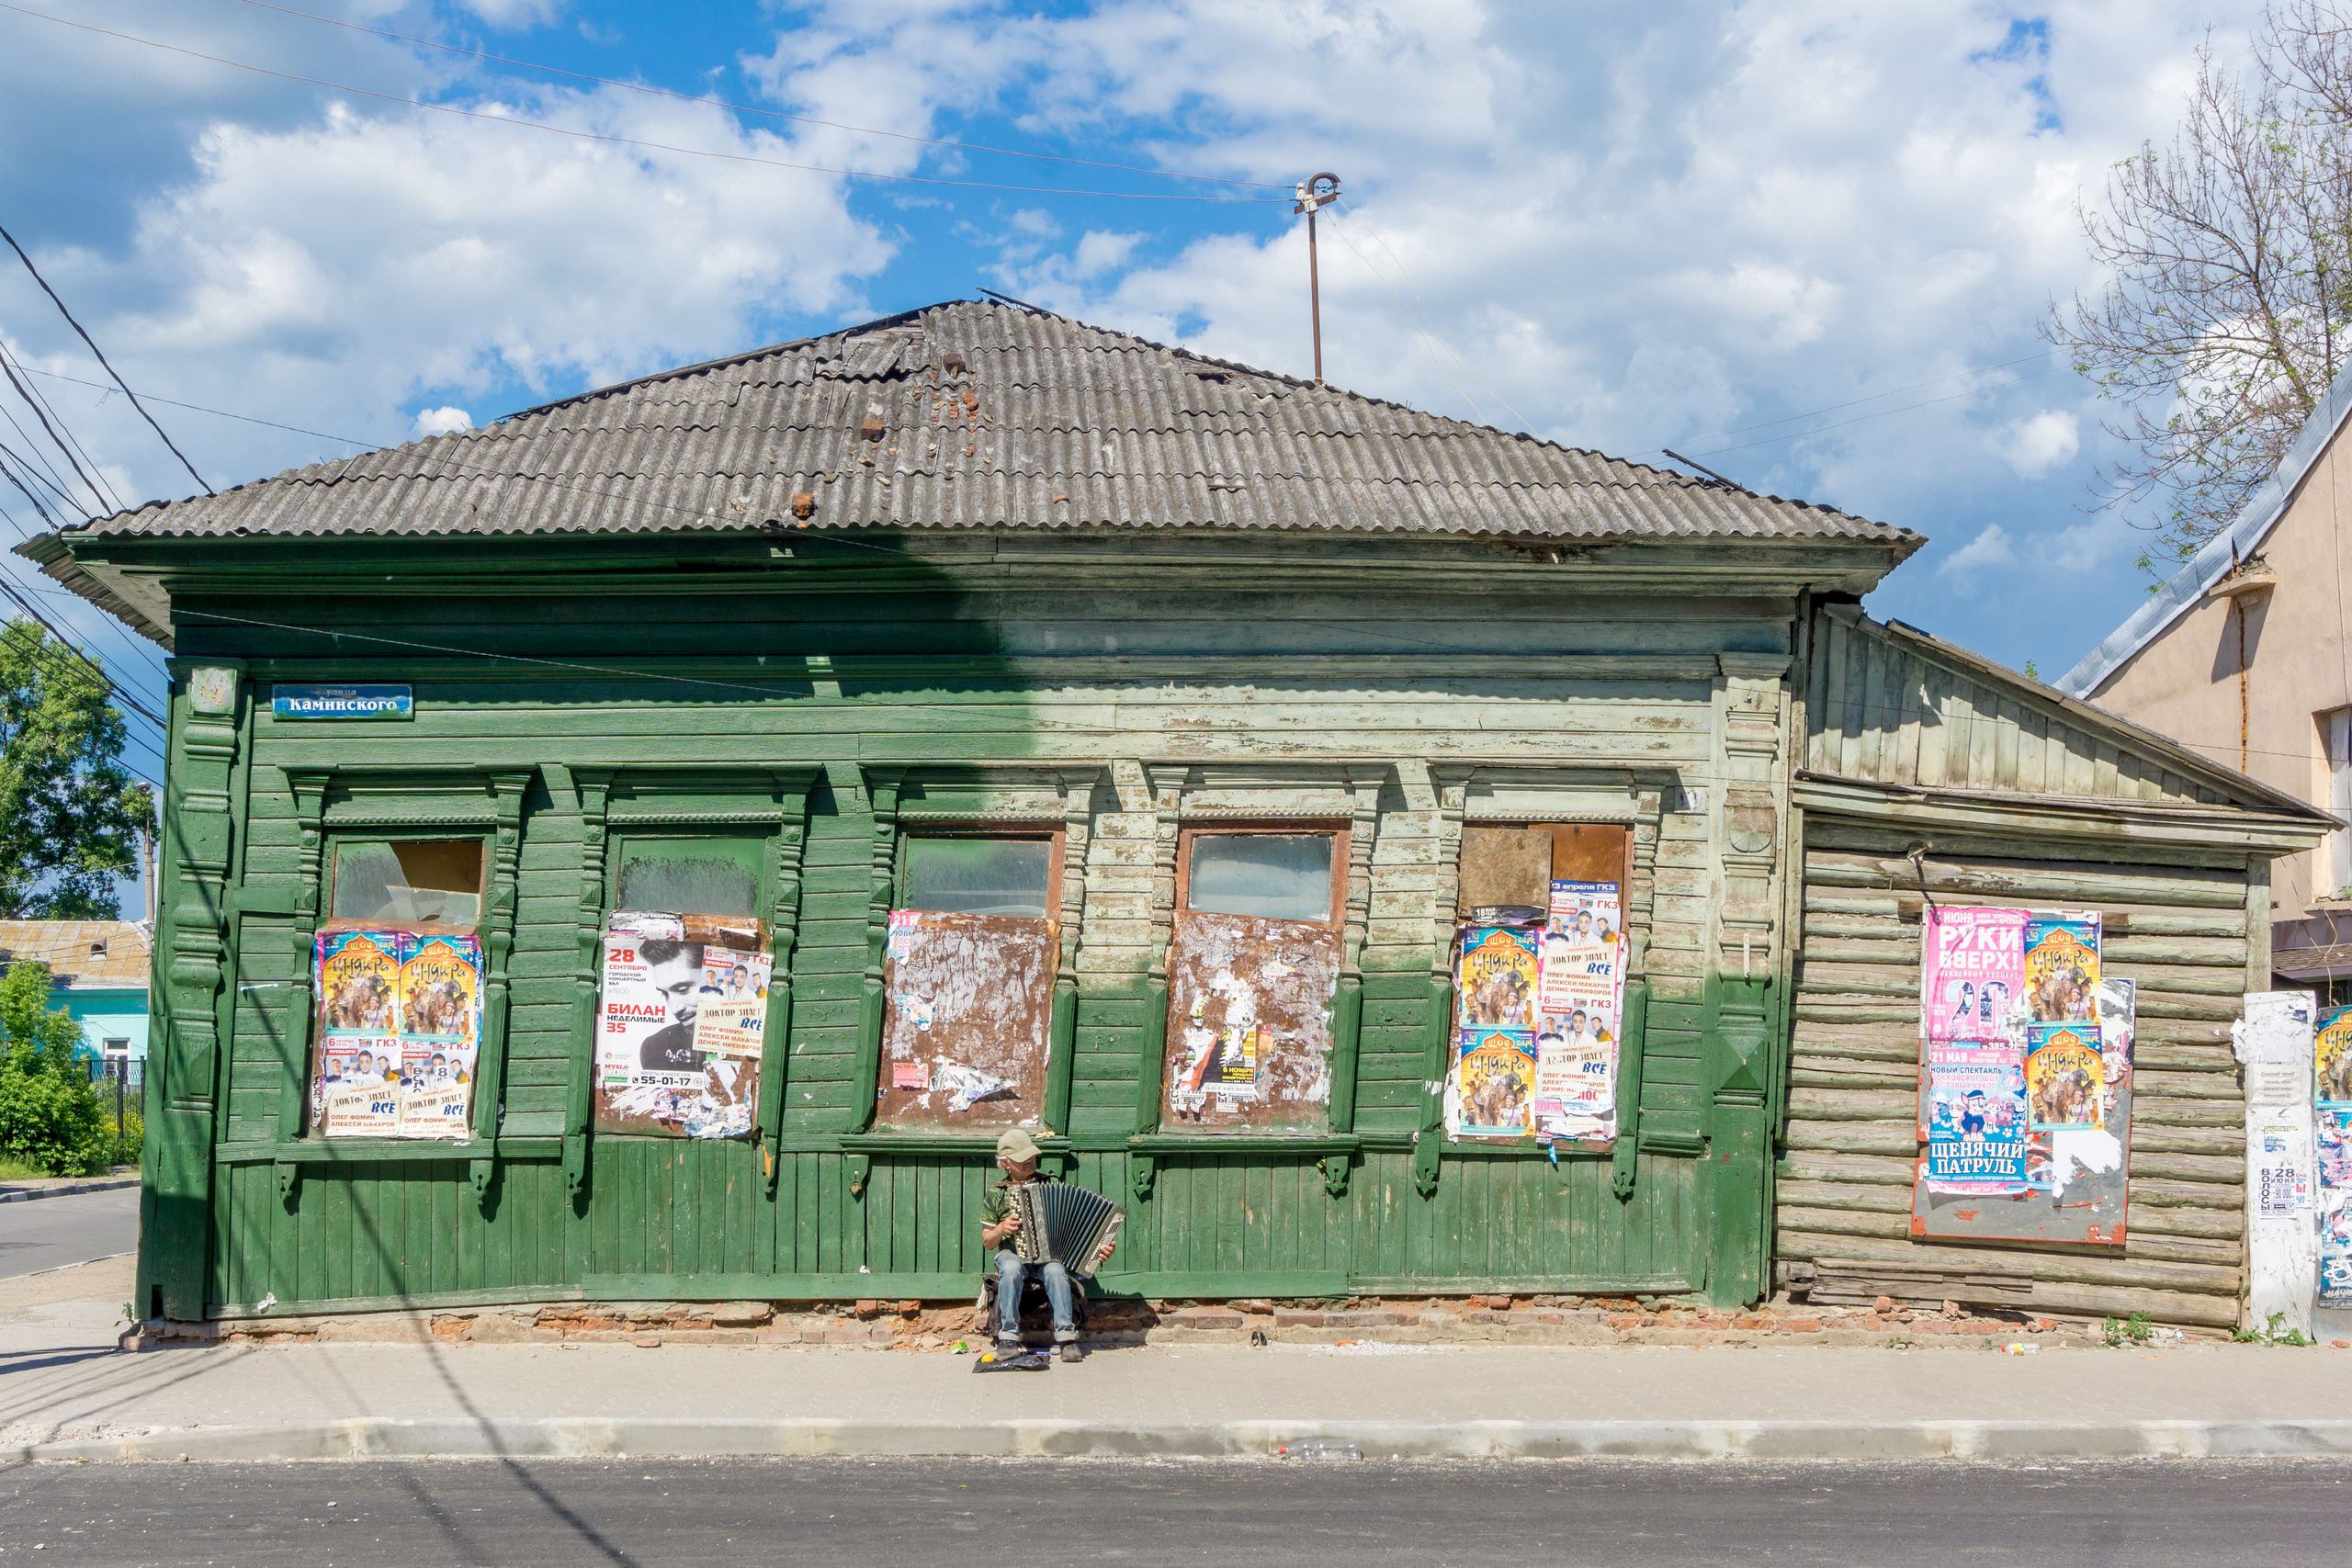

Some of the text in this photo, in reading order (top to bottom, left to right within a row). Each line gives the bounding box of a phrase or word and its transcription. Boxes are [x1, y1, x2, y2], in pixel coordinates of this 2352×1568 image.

[289, 698, 397, 711] Каминского
[1598, 900, 1618, 909] ГКЗ
[1944, 912, 1973, 923] ИЮНЯ
[1939, 926, 2018, 950] РУКИ
[610, 949, 634, 963] 28
[707, 949, 712, 957] 6
[753, 955, 769, 965] ГКЗ
[1584, 953, 1608, 961] ЗНАЕТ
[1939, 951, 2018, 970] ВВЕРХ!
[1588, 962, 1611, 976] ВСЁ
[1544, 996, 1550, 1004] 6
[1591, 999, 1611, 1008] ГКЗ
[1946, 979, 2010, 1037] 20
[608, 1003, 665, 1016] БИЛАН
[607, 1015, 665, 1023] НЕДЕЛИМЫЕ
[741, 1018, 763, 1031] ВСЁ
[607, 1022, 626, 1032] 35
[329, 1038, 335, 1046] 6
[377, 1039, 397, 1047] ГКЗ
[1546, 1052, 1602, 1066] ДТОР ЗНАЕТ
[1932, 1052, 1967, 1063] 21 МАЯ
[1582, 1062, 1607, 1075] ВСЁ
[641, 1077, 691, 1086] 55-01-17
[334, 1091, 391, 1107] ДОКТО ЗНАЕТ
[440, 1094, 462, 1104] ЗНАЕТ
[371, 1100, 395, 1113] ВСЁ
[444, 1103, 465, 1115] ВСЁ
[1931, 1140, 2024, 1159] ЩЕНЯЧИЙ
[1937, 1158, 2017, 1174] ПАТРУЛЬ
[2275, 1168, 2295, 1177] 28
[2261, 1168, 2270, 1210] ВОЛОСЫ
